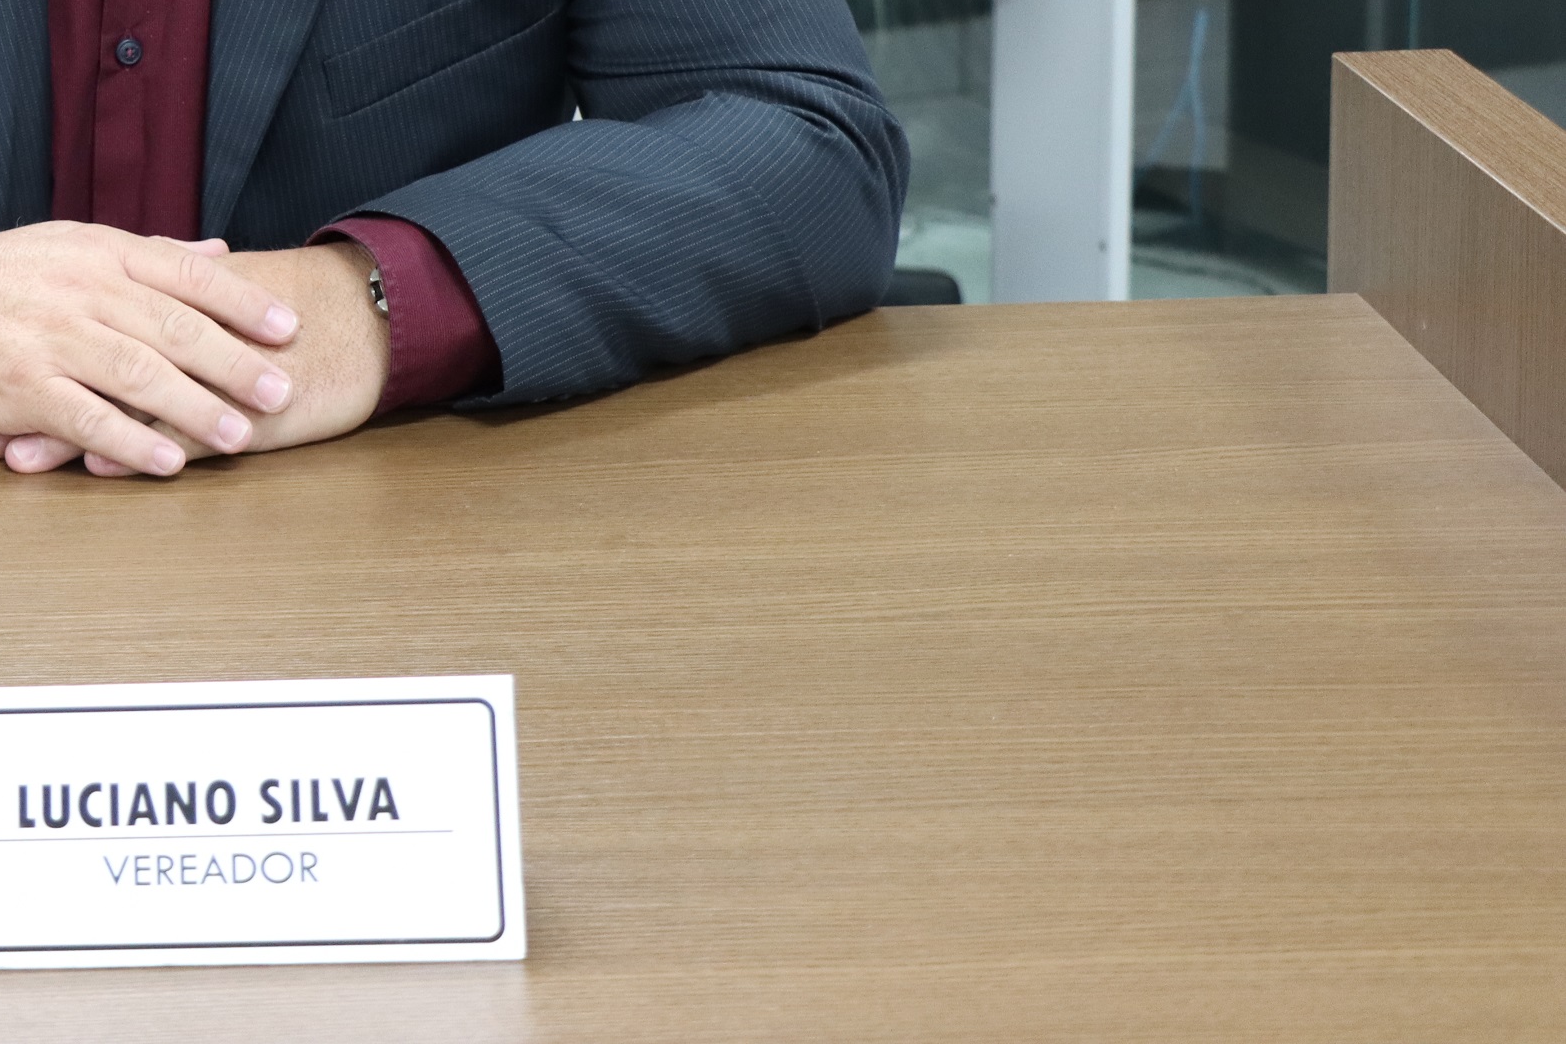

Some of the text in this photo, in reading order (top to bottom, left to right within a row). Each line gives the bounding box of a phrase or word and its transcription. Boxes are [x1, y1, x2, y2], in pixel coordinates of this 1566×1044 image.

[18, 777, 401, 829] LUCIANO SILVA
[102, 851, 319, 886] VEREADOR
